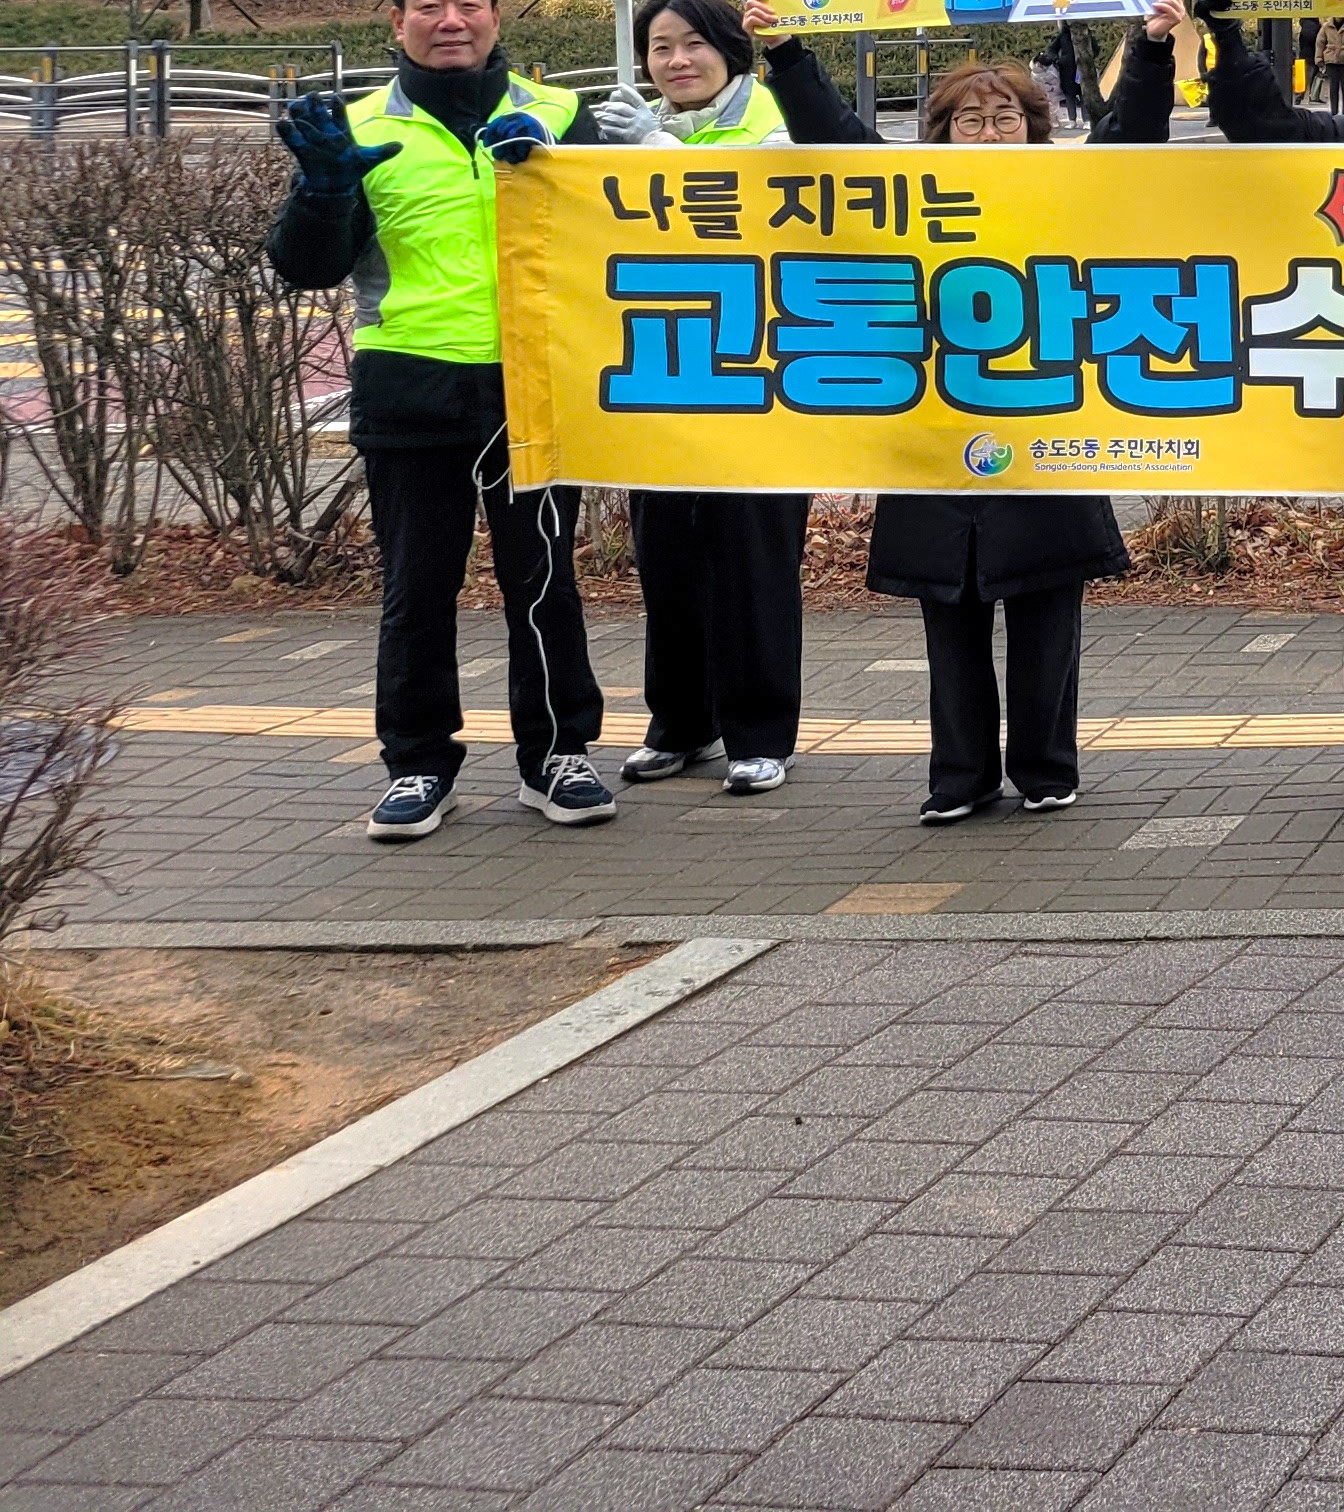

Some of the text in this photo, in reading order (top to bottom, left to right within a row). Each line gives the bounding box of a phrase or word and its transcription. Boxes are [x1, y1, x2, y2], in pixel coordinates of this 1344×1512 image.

[1227, 0, 1313, 11] 도5동 주민자치회
[811, 13, 863, 26] 주민자치회
[603, 171, 982, 244] 나를 지키는
[1029, 439, 1200, 459] 송도5동 주민자치회
